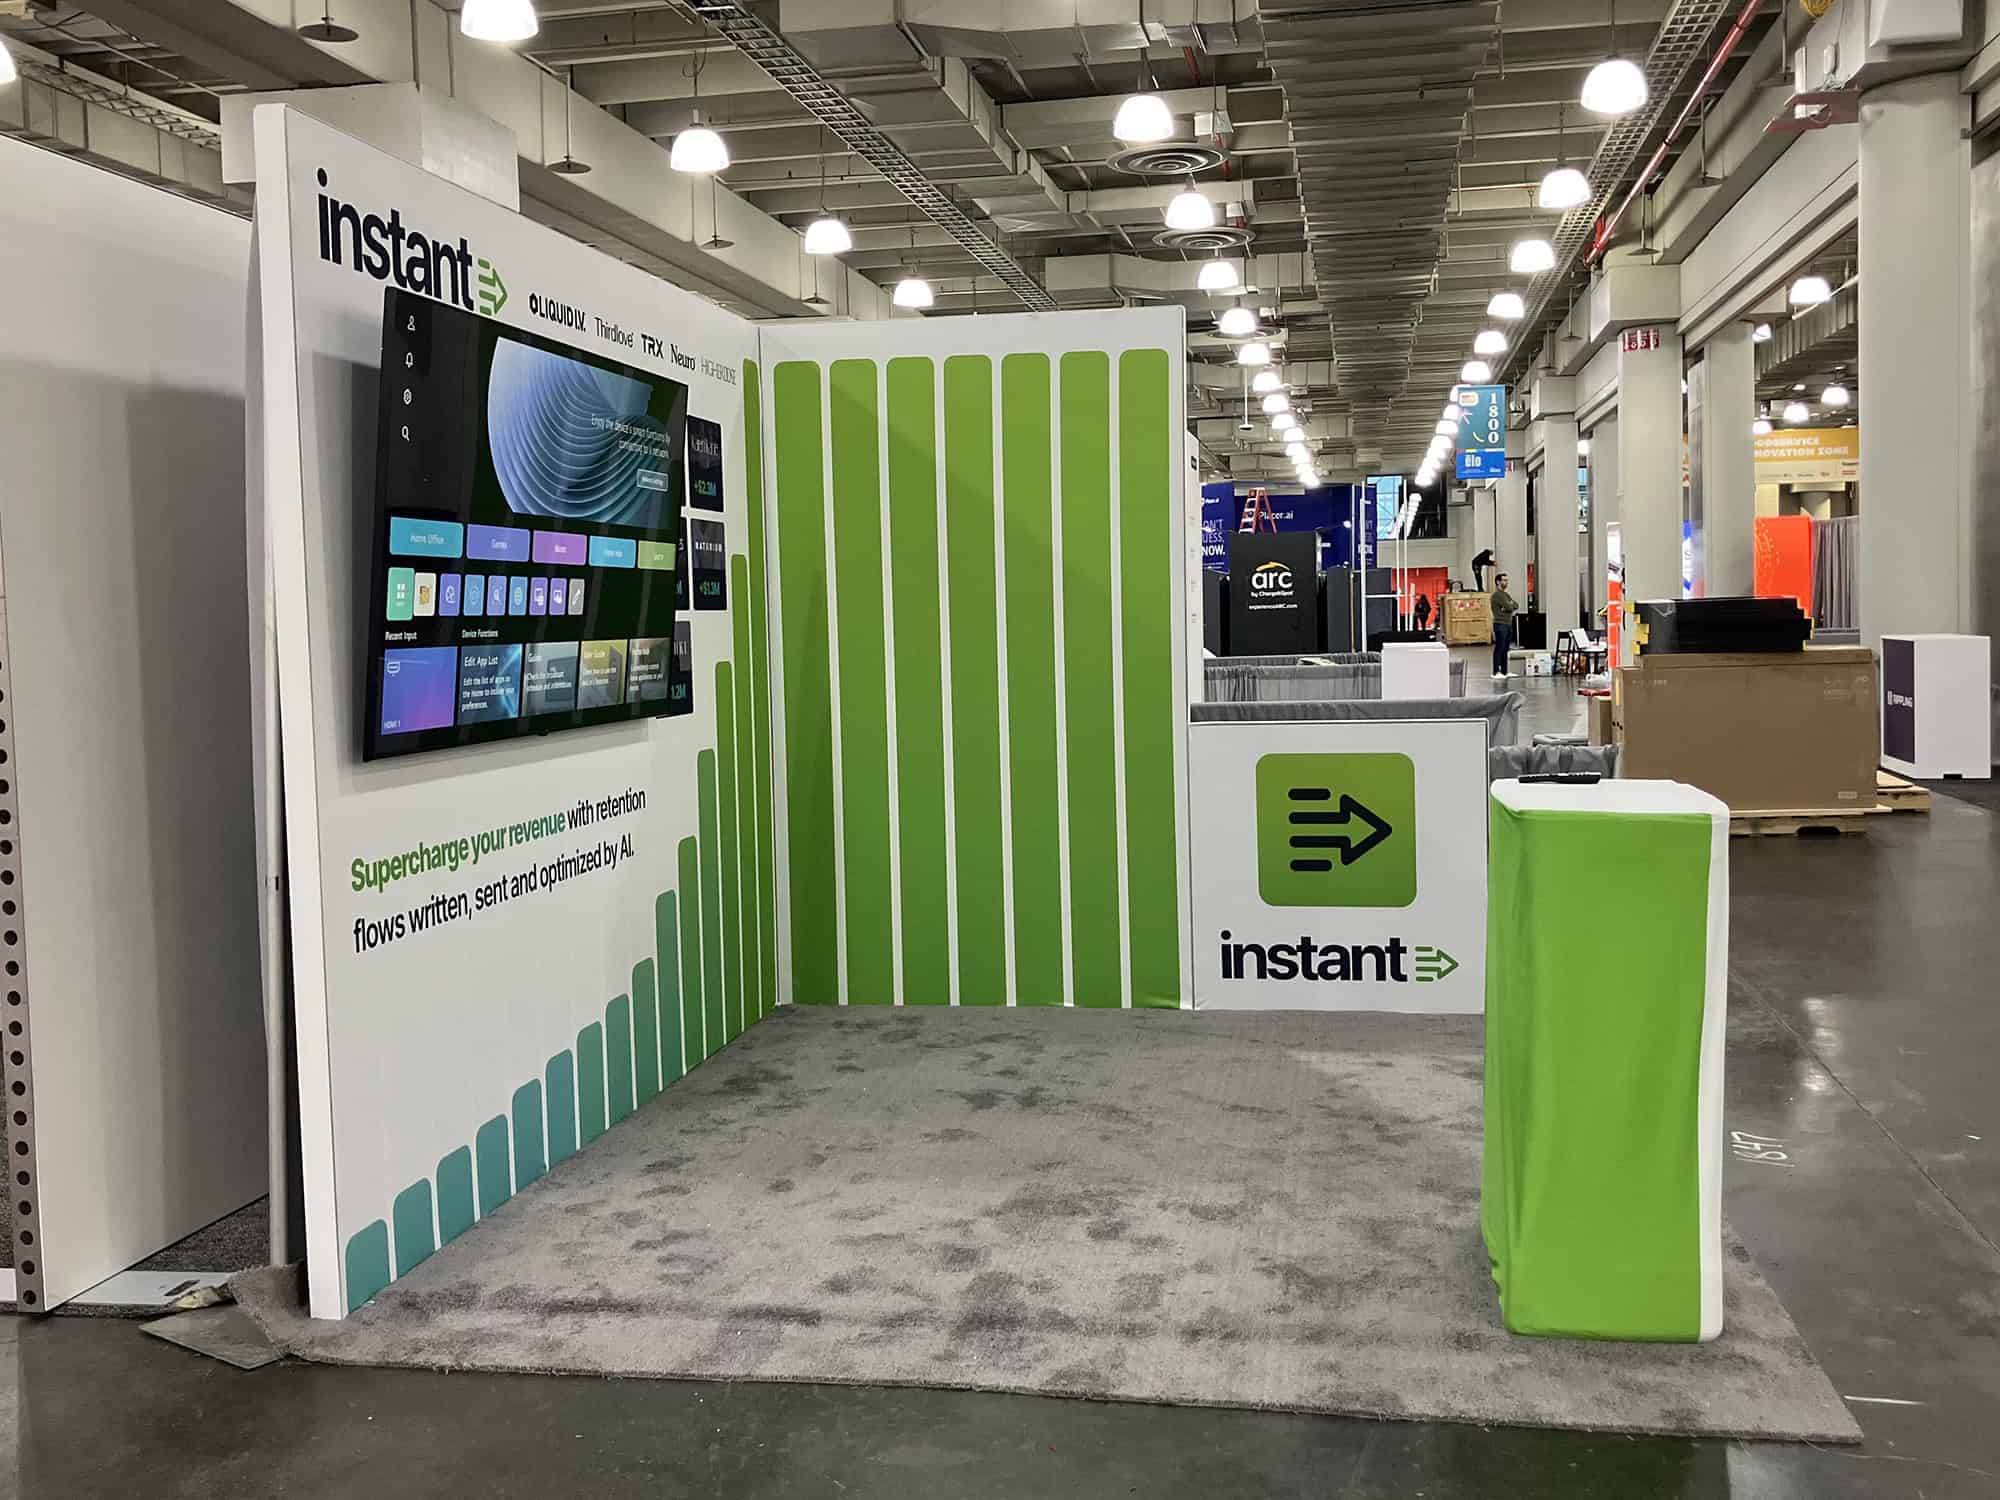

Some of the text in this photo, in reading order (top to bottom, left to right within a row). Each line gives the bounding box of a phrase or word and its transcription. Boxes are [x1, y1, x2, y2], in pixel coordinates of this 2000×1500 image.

[317, 168, 474, 311] instant
[538, 295, 574, 327] LIQUID
[641, 333, 664, 360] TRX
[670, 343, 696, 371] Neuro
[1487, 392, 1499, 444] 1800
[1202, 519, 1223, 530] ON'T
[1202, 532, 1225, 544] UESS,
[1202, 545, 1226, 557] NOW.
[1251, 571, 1293, 589] arc
[464, 656, 499, 669] Edit App List
[351, 787, 646, 893] Supercharge your revenue with retention
[353, 832, 635, 953] flows written, sent and optimized by AI.
[1220, 930, 1408, 983] instant
